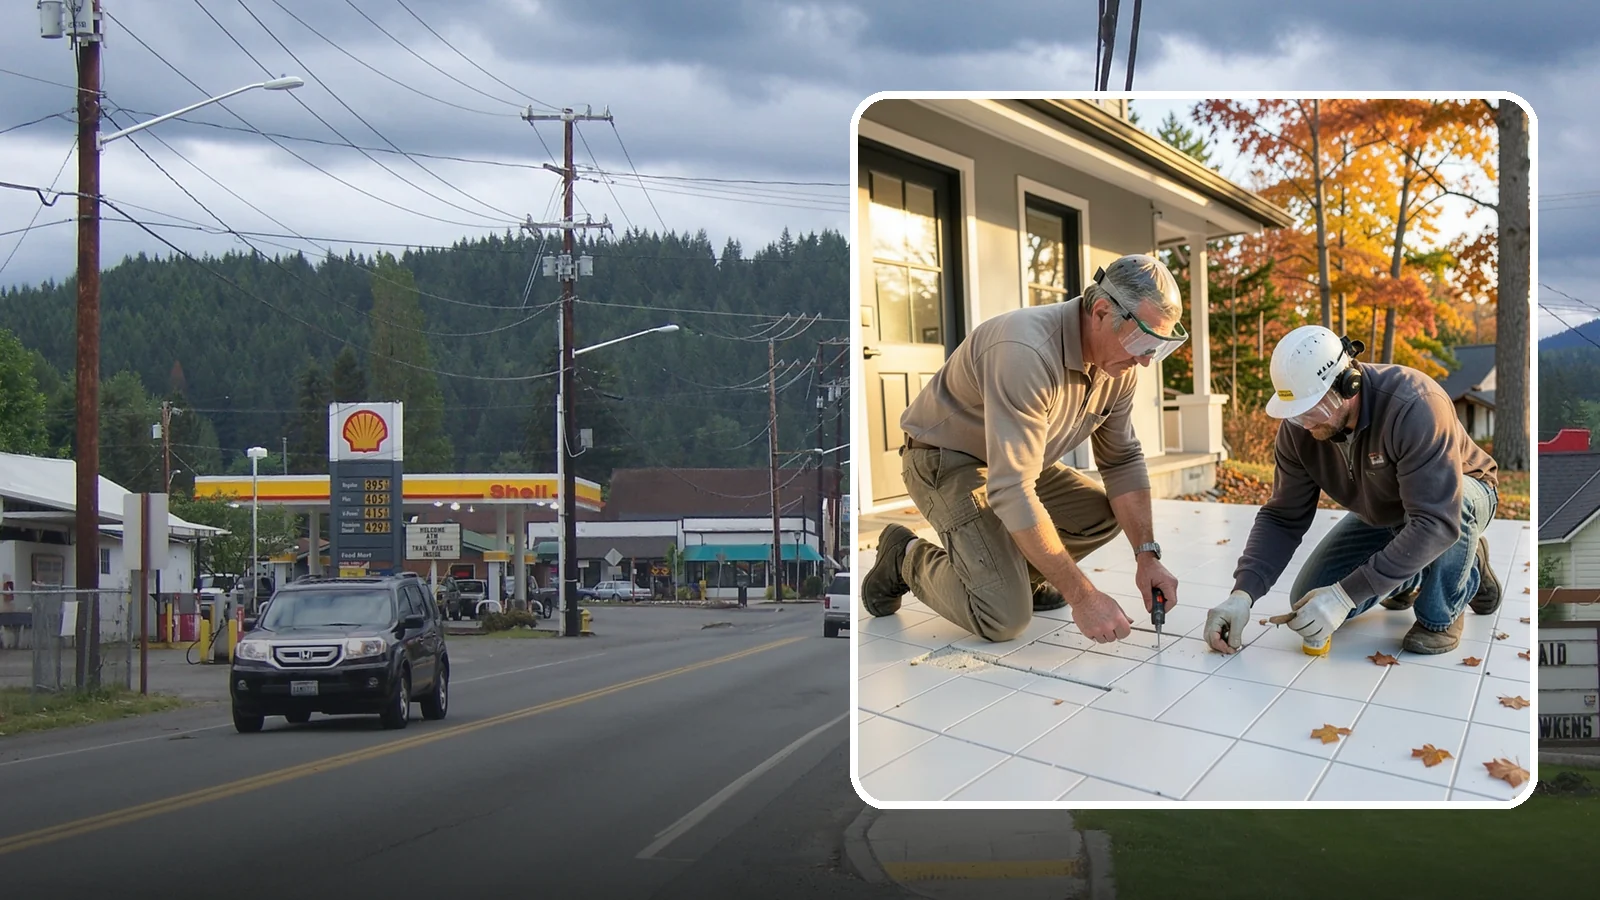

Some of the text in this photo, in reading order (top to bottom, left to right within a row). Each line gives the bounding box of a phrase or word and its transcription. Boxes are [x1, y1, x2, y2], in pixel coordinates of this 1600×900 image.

[490, 484, 548, 499] Shell
[1538, 643, 1567, 666] AID
[1538, 716, 1592, 739] WKENS
